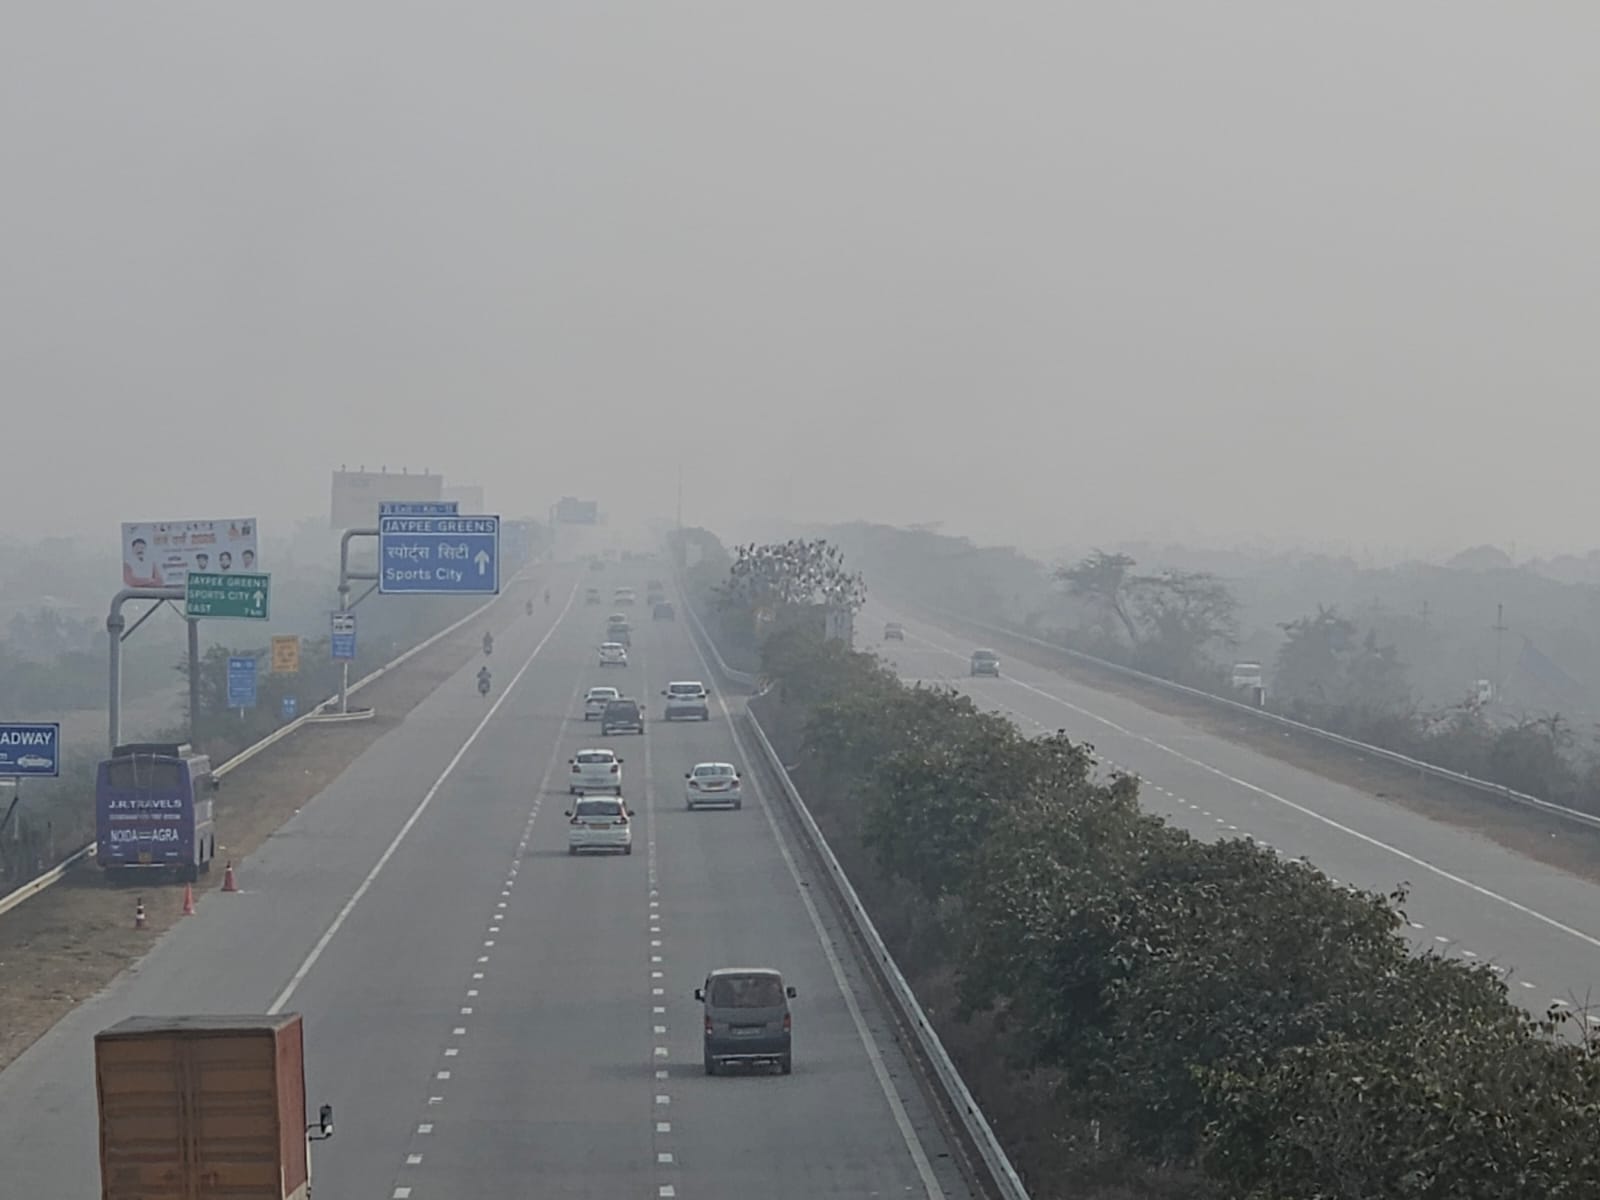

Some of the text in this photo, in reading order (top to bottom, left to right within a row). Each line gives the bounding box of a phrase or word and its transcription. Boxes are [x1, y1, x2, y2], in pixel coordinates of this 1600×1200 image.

[386, 520, 494, 532] JAYPEE GREENS
[438, 543, 469, 559] सिटी
[189, 575, 267, 588] JAYPEE GREENS
[386, 568, 463, 582] Sports City
[188, 590, 250, 600] SPORTS CITY
[188, 603, 211, 614] EAST
[151, 828, 179, 842] AGRA
